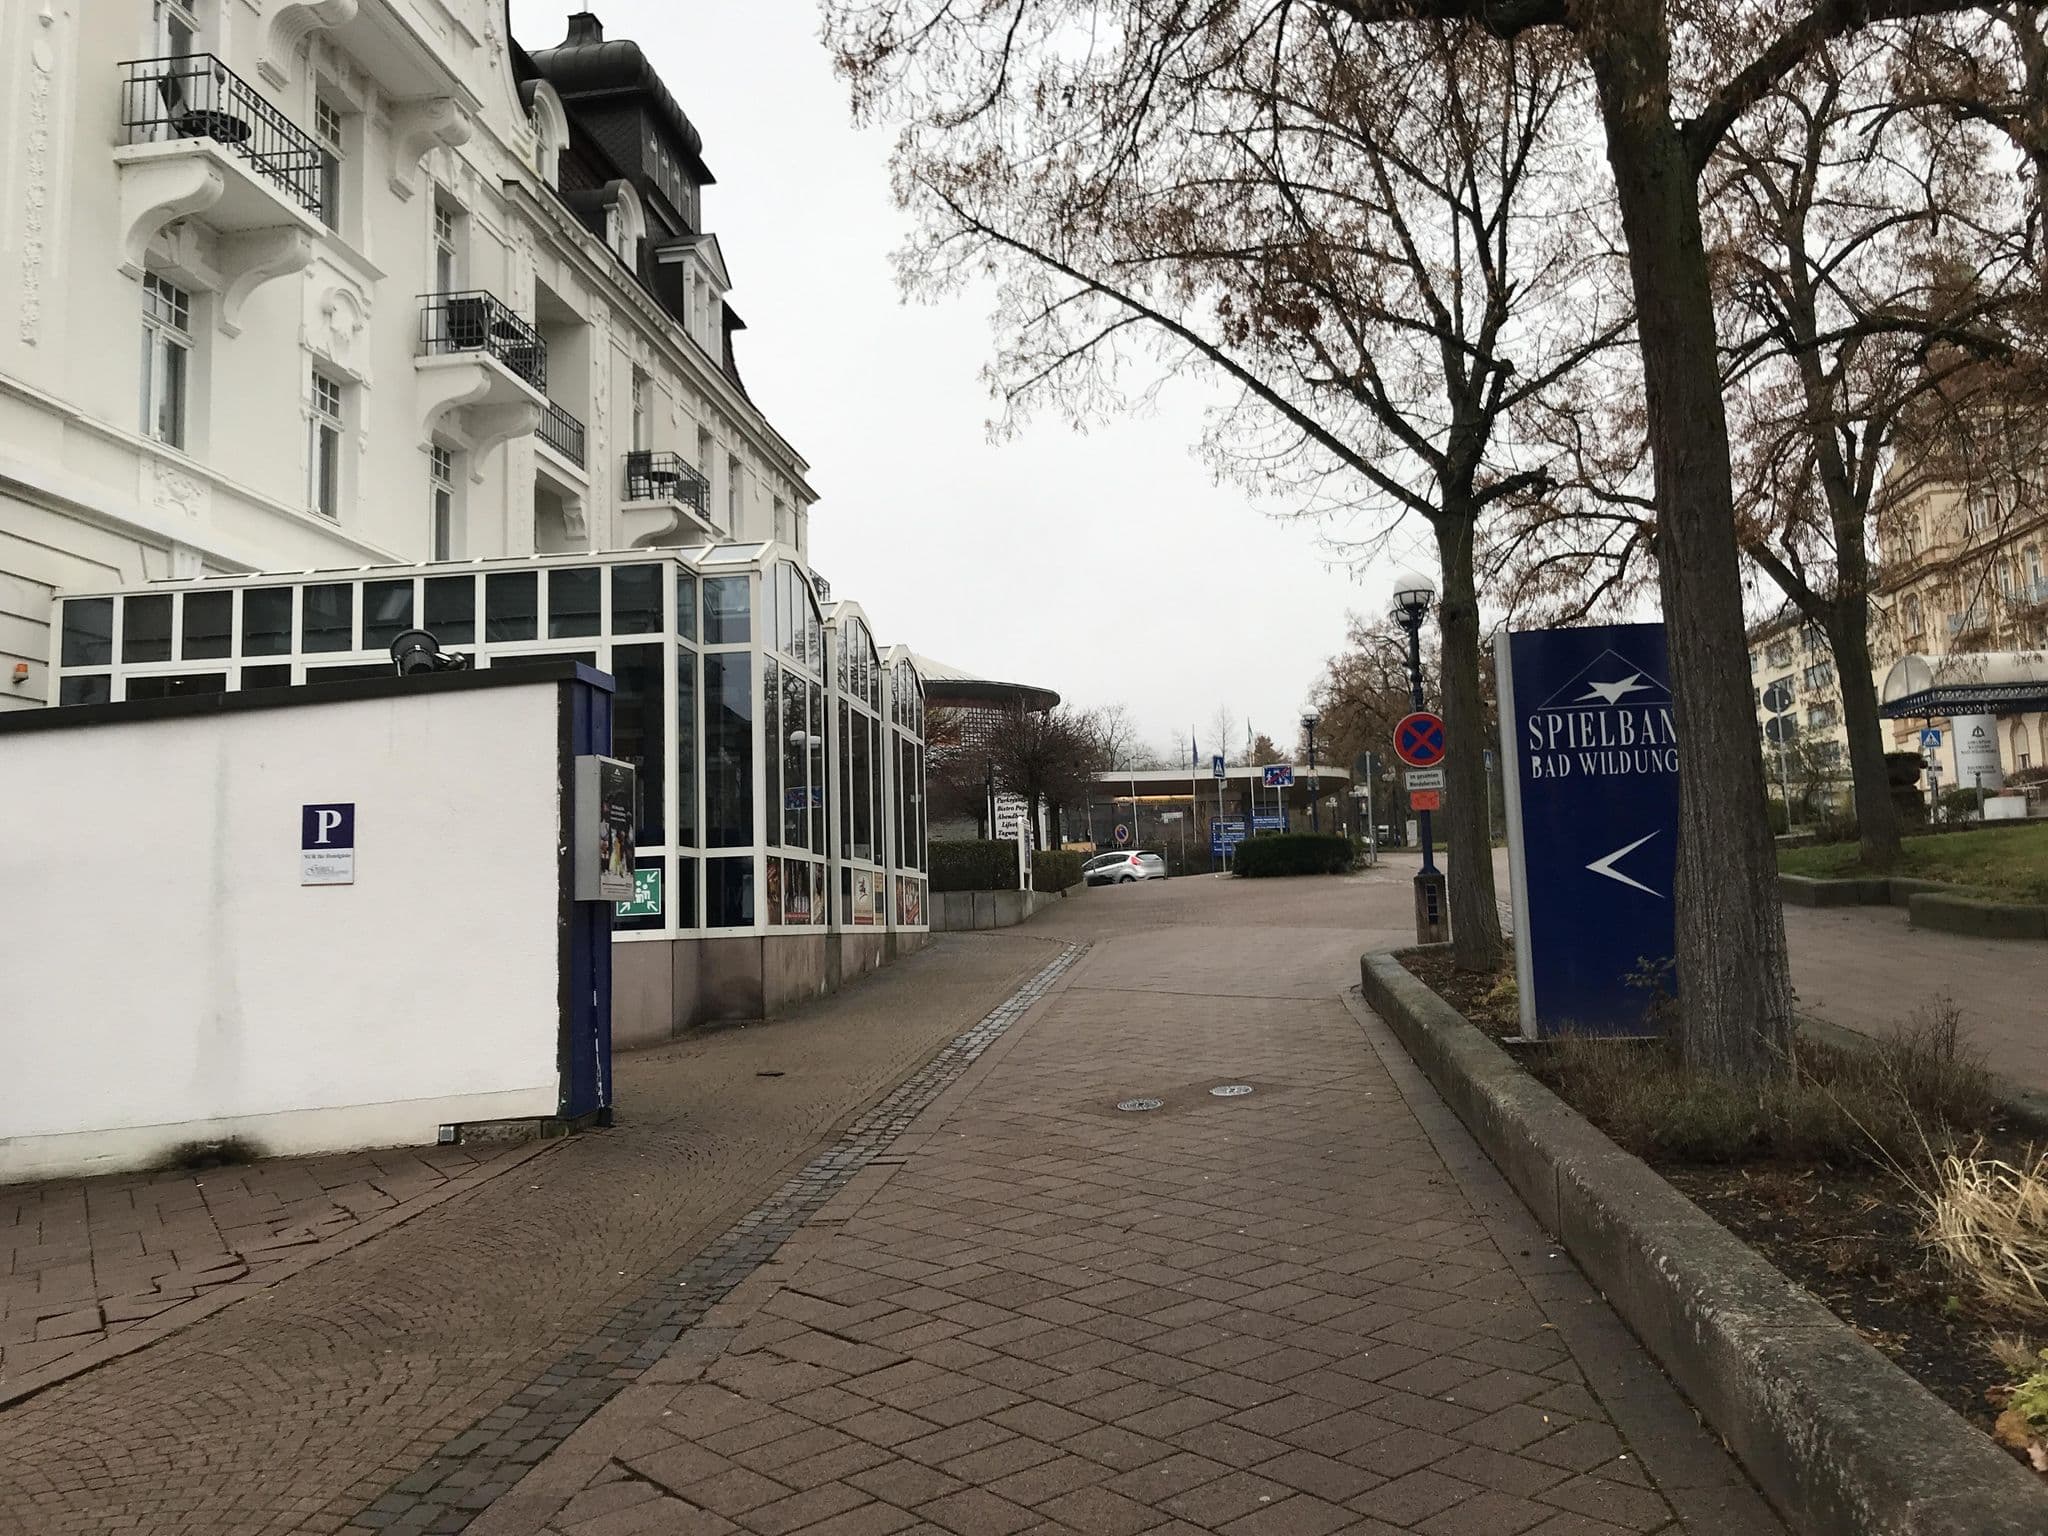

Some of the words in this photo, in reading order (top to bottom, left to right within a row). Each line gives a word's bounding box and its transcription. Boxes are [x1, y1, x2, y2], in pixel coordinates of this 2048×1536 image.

[1531, 754, 1571, 778] BAD
[1579, 749, 1679, 777] WILDUNG
[314, 810, 342, 844] P
